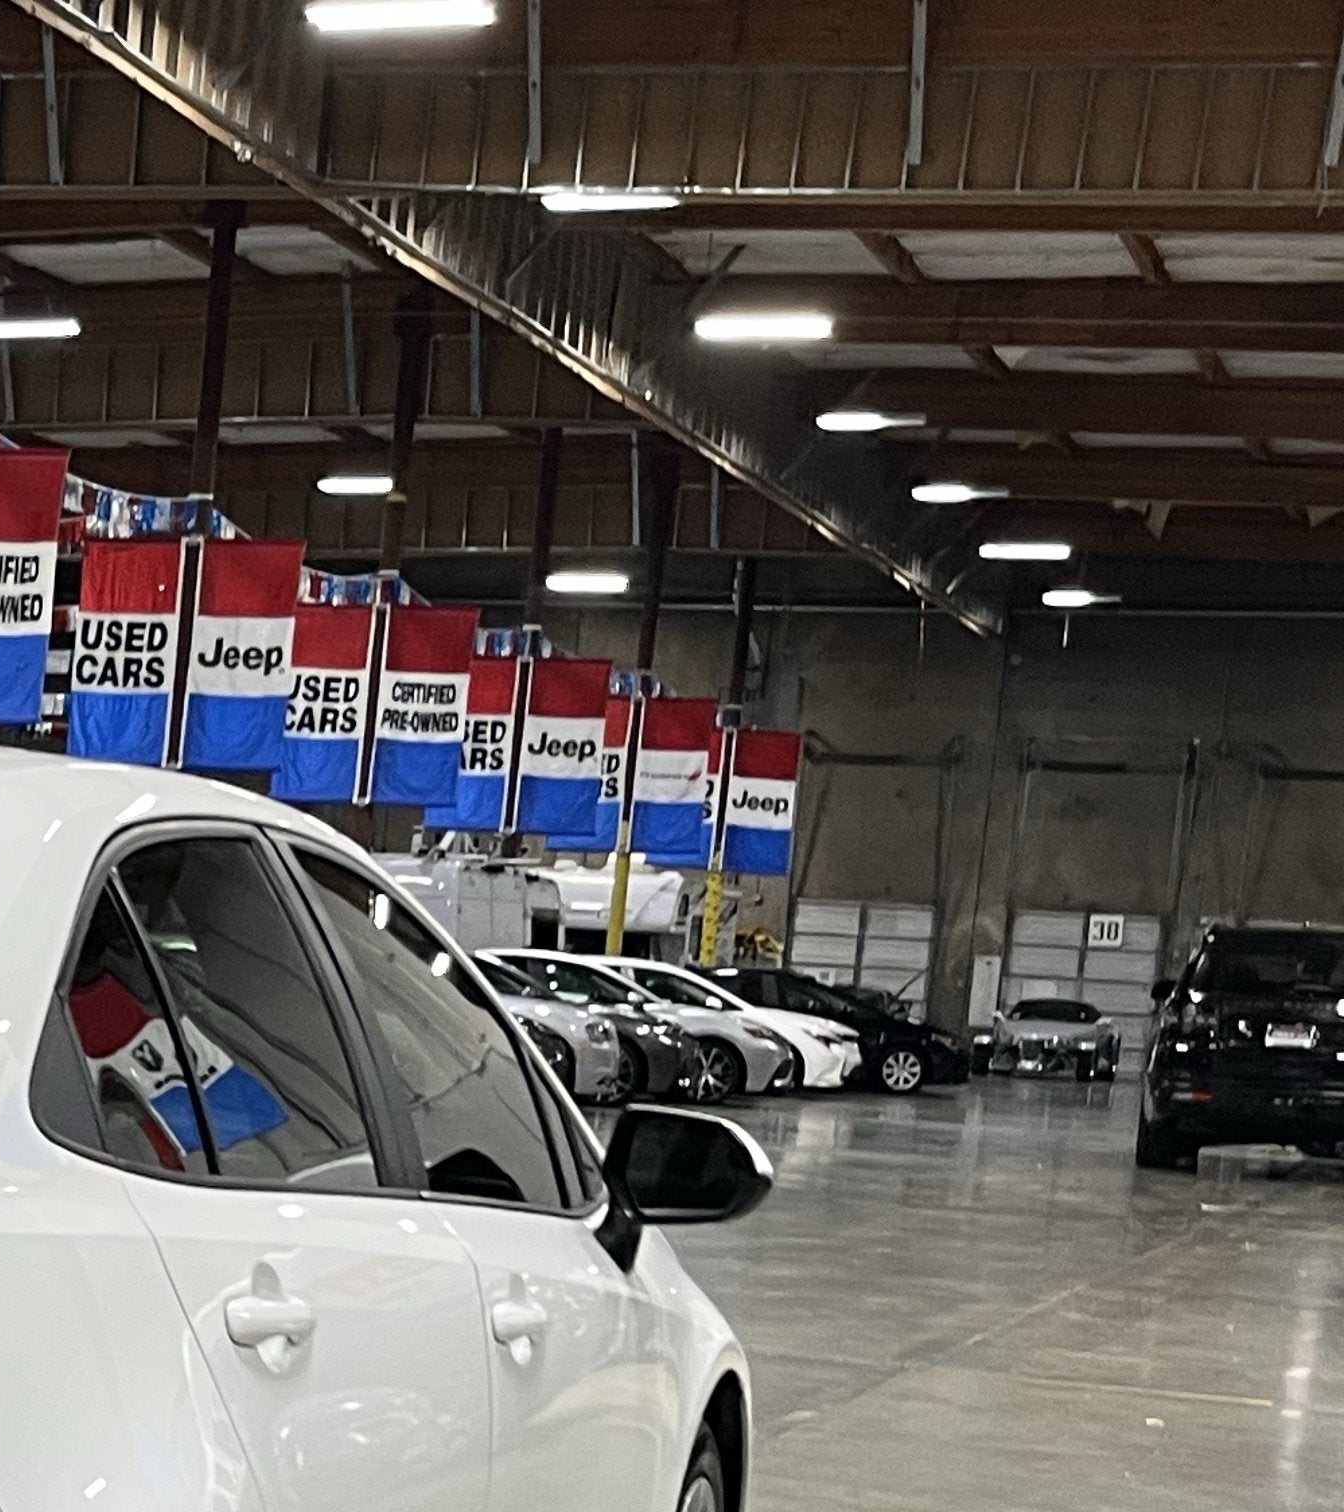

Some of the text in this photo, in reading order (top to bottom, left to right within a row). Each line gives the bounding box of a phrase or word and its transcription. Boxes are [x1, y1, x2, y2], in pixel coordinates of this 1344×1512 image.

[80, 619, 168, 653] USED
[76, 654, 165, 688] CARS
[198, 637, 283, 676] Jeep
[392, 682, 456, 705] CERTIFIED
[380, 708, 459, 732] PRE-OWNED
[528, 732, 596, 763] Jeep
[732, 789, 788, 816] Jeep
